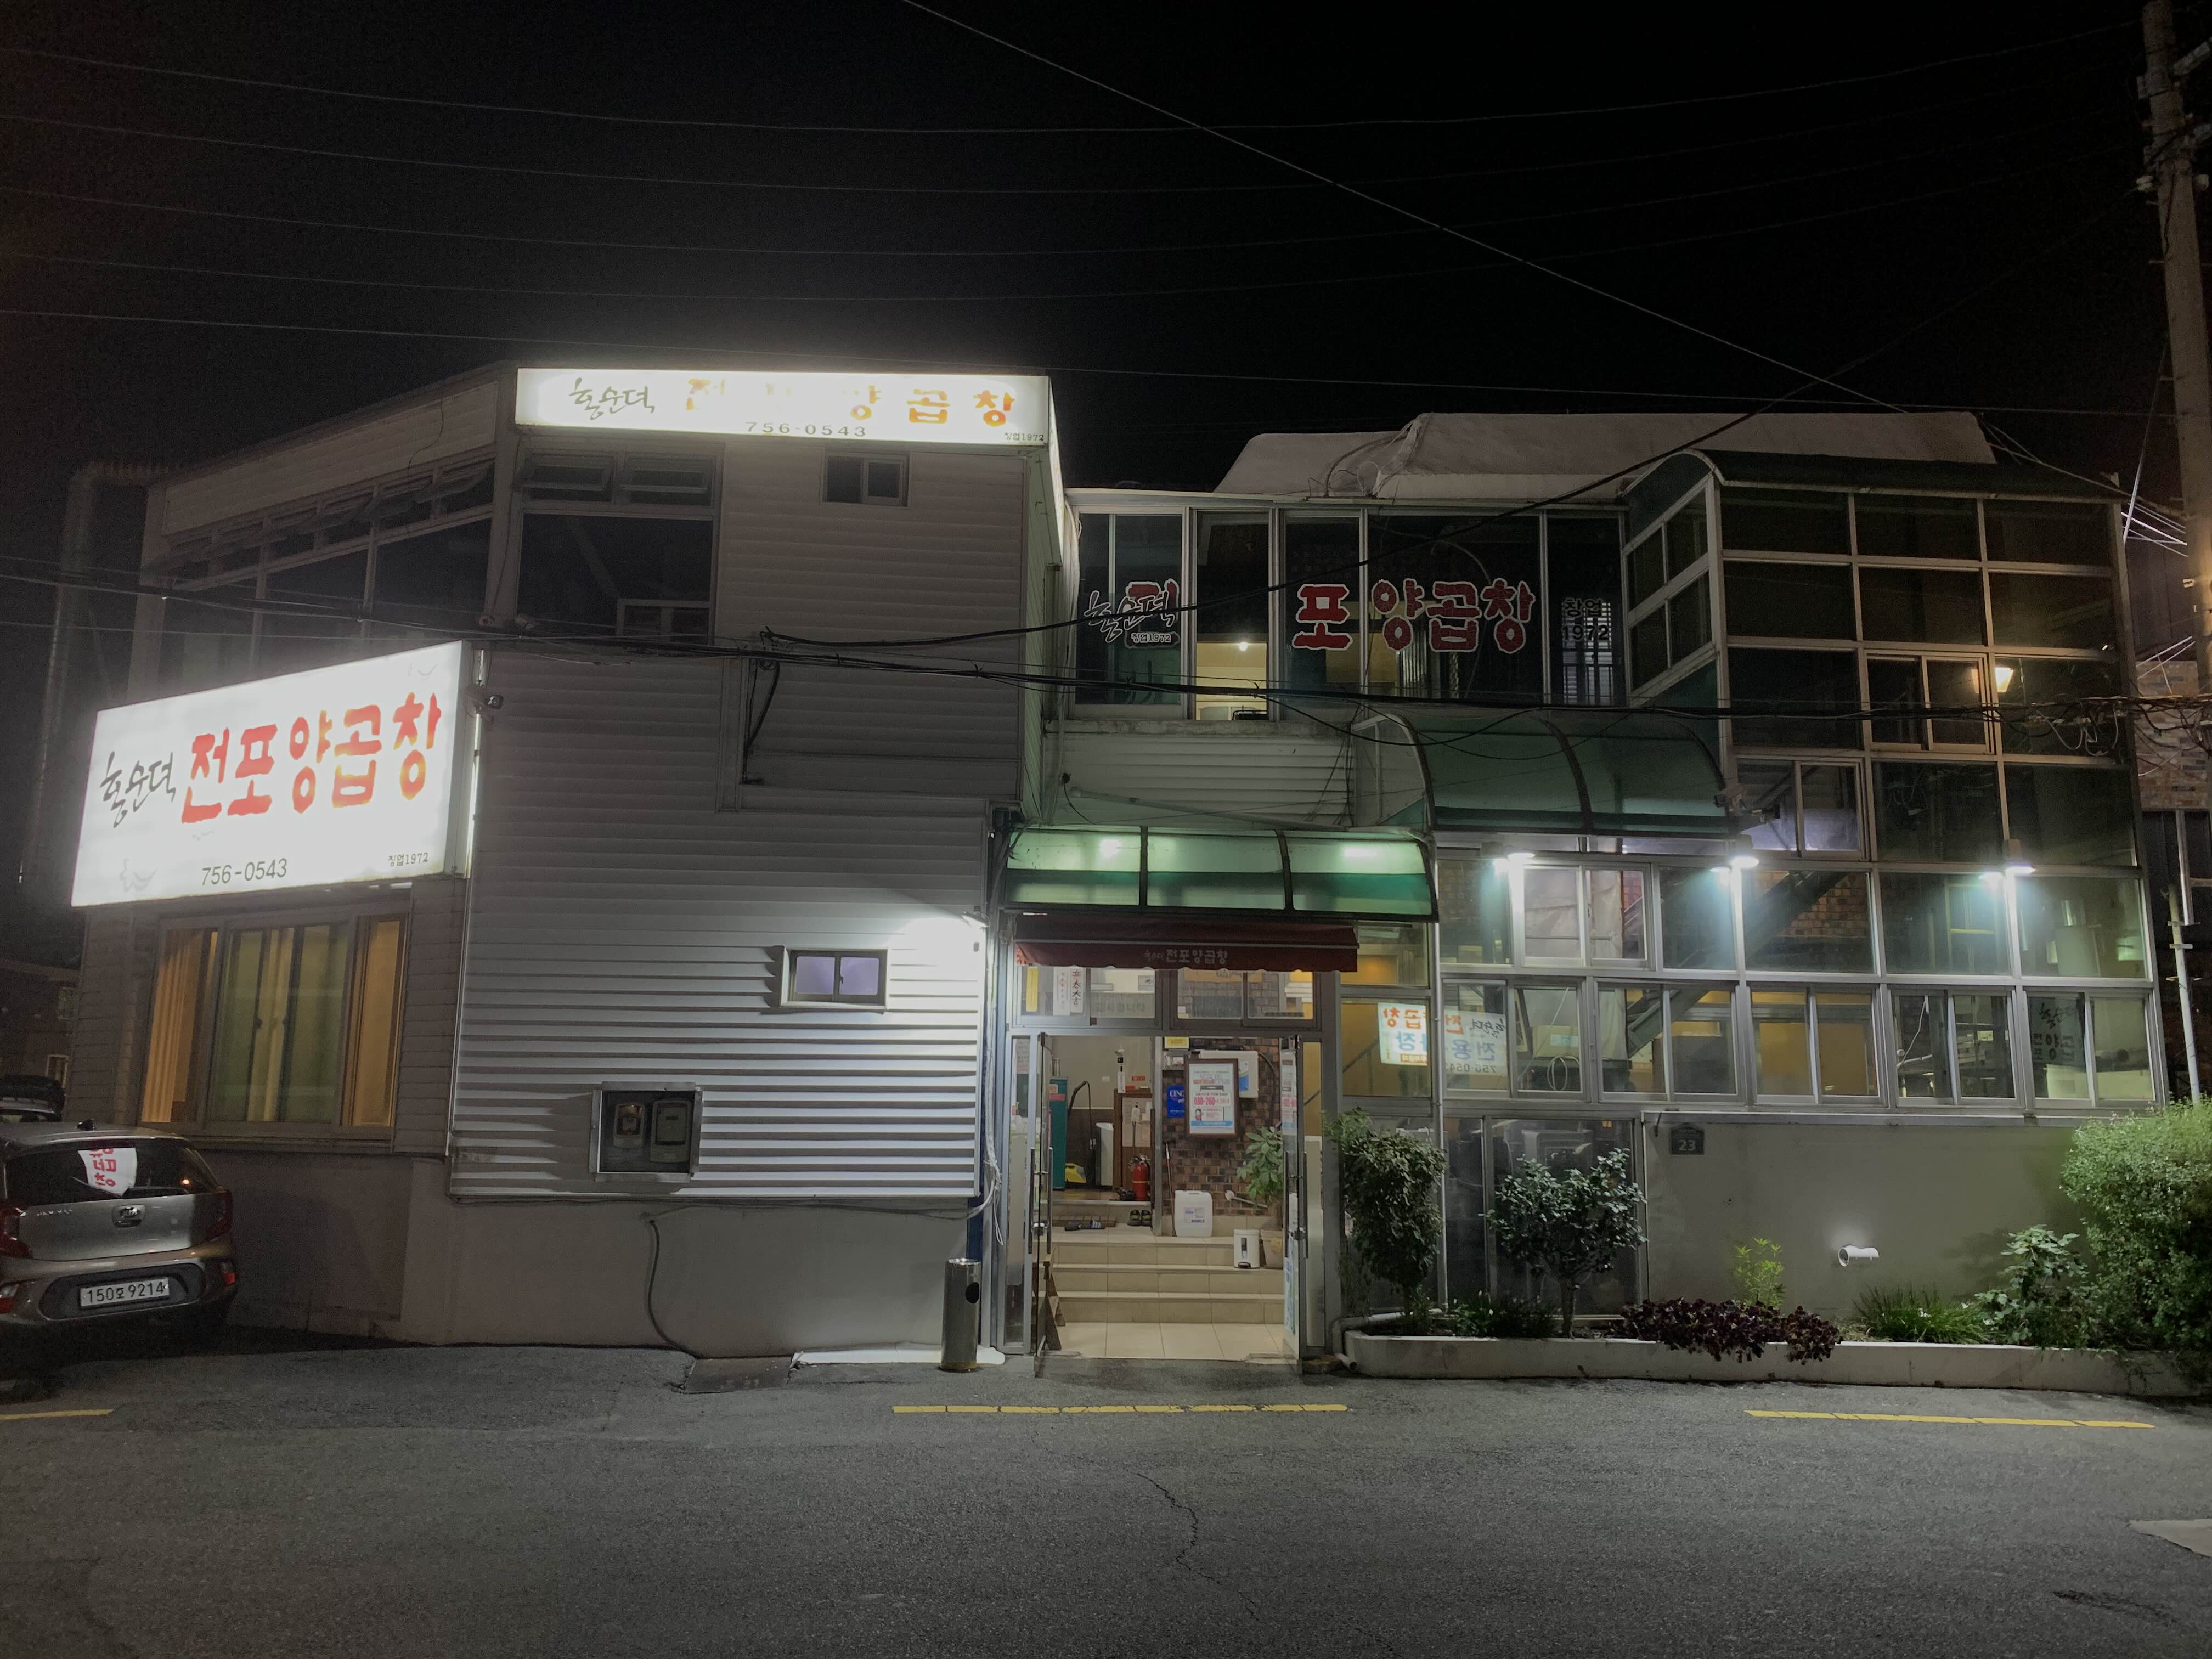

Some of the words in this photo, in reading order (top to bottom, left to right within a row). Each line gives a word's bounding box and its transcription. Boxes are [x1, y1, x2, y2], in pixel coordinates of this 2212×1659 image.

[746, 421, 866, 437] 756-0543
[1561, 598, 1602, 618] 창업
[1561, 625, 1610, 641] 1972
[181, 691, 442, 824] 전포양곱창
[201, 857, 287, 885] 756-0543
[1166, 949, 1228, 965] 전포양곱창
[1679, 1140, 1696, 1150] 23
